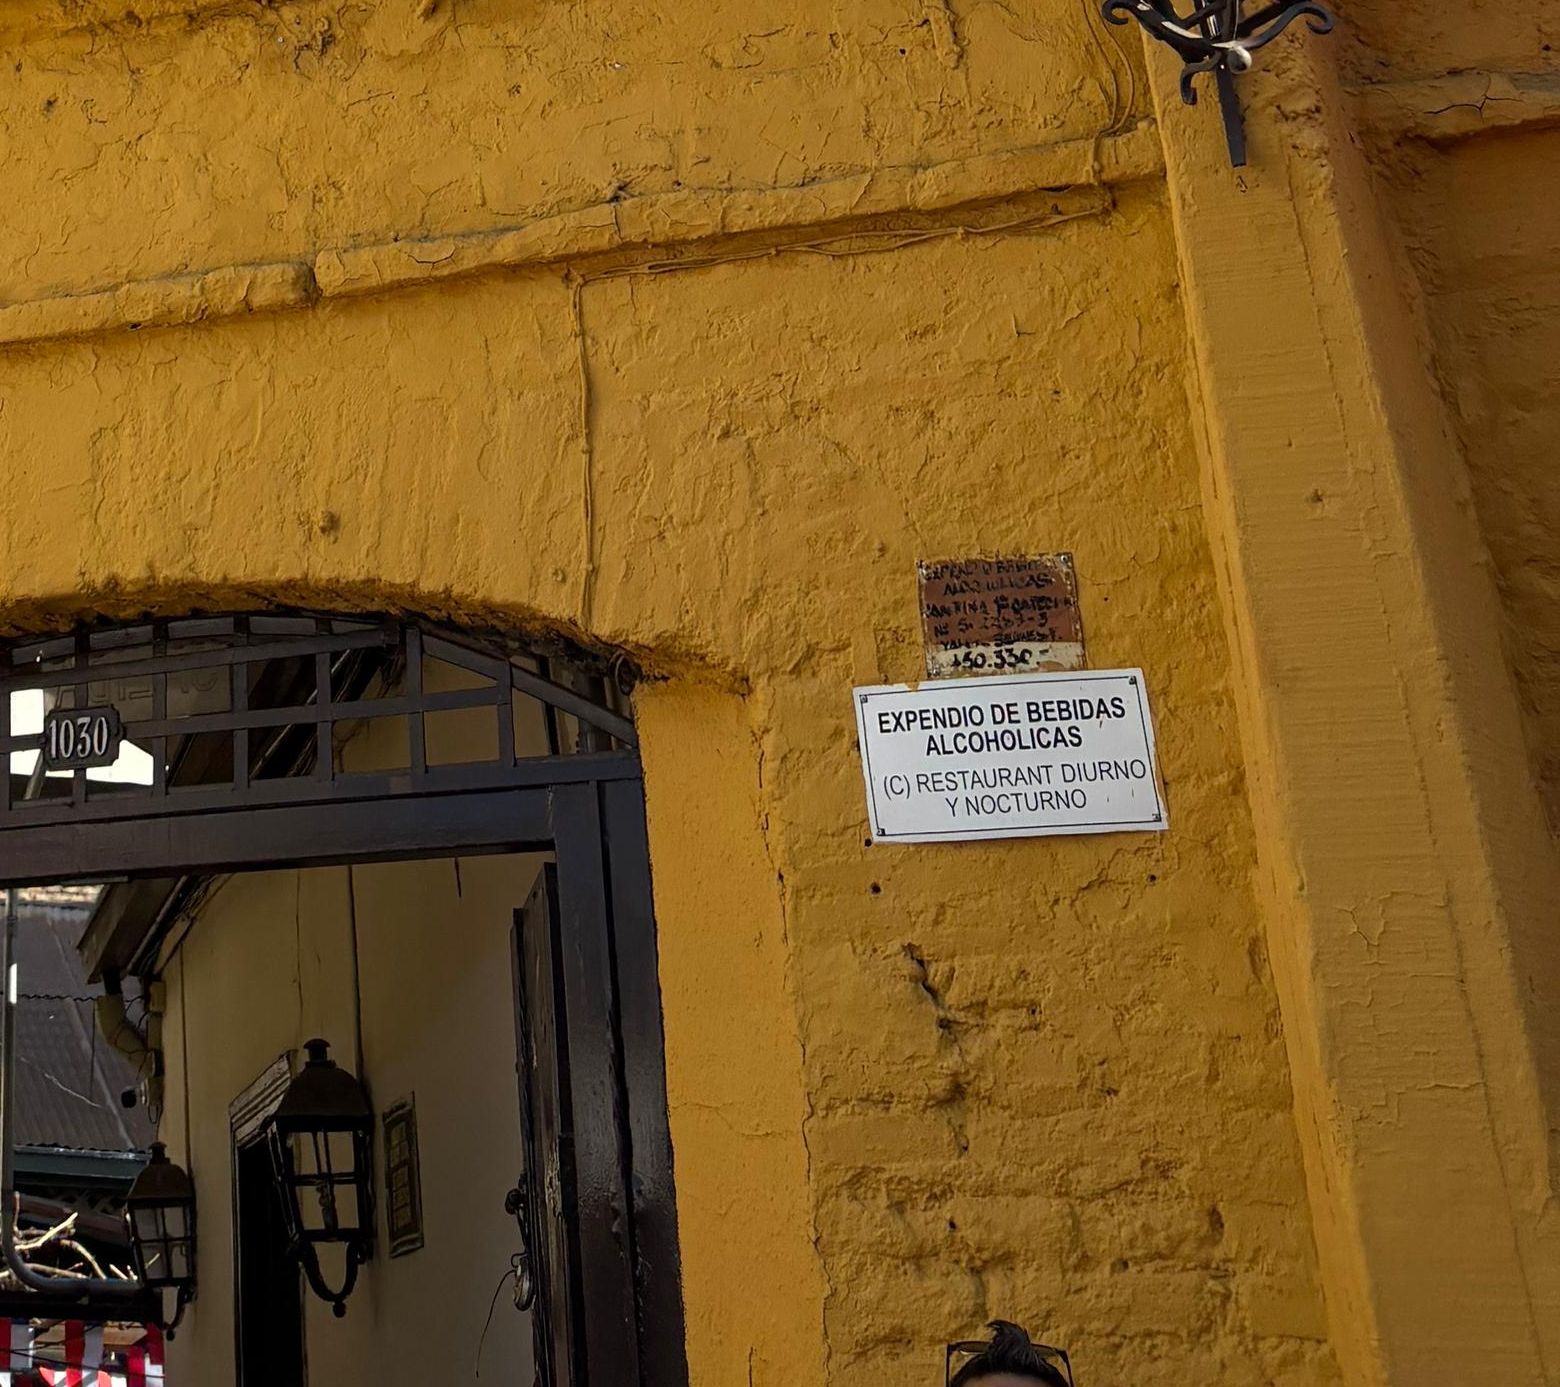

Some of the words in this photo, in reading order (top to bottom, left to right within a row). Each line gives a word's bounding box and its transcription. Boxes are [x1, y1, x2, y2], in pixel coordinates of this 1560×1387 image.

[878, 705, 984, 734] EXPENDIO
[990, 702, 1022, 726] DE
[1027, 696, 1126, 723] BEBIDAS
[48, 716, 109, 759] 1030
[926, 725, 1083, 756] ALCOHOLICAS
[883, 774, 911, 800] (C)
[917, 764, 1054, 794] RESTAURANT
[1061, 758, 1147, 784] DIURNO
[945, 796, 959, 817] Y
[965, 788, 1088, 817] NOCTURNO
